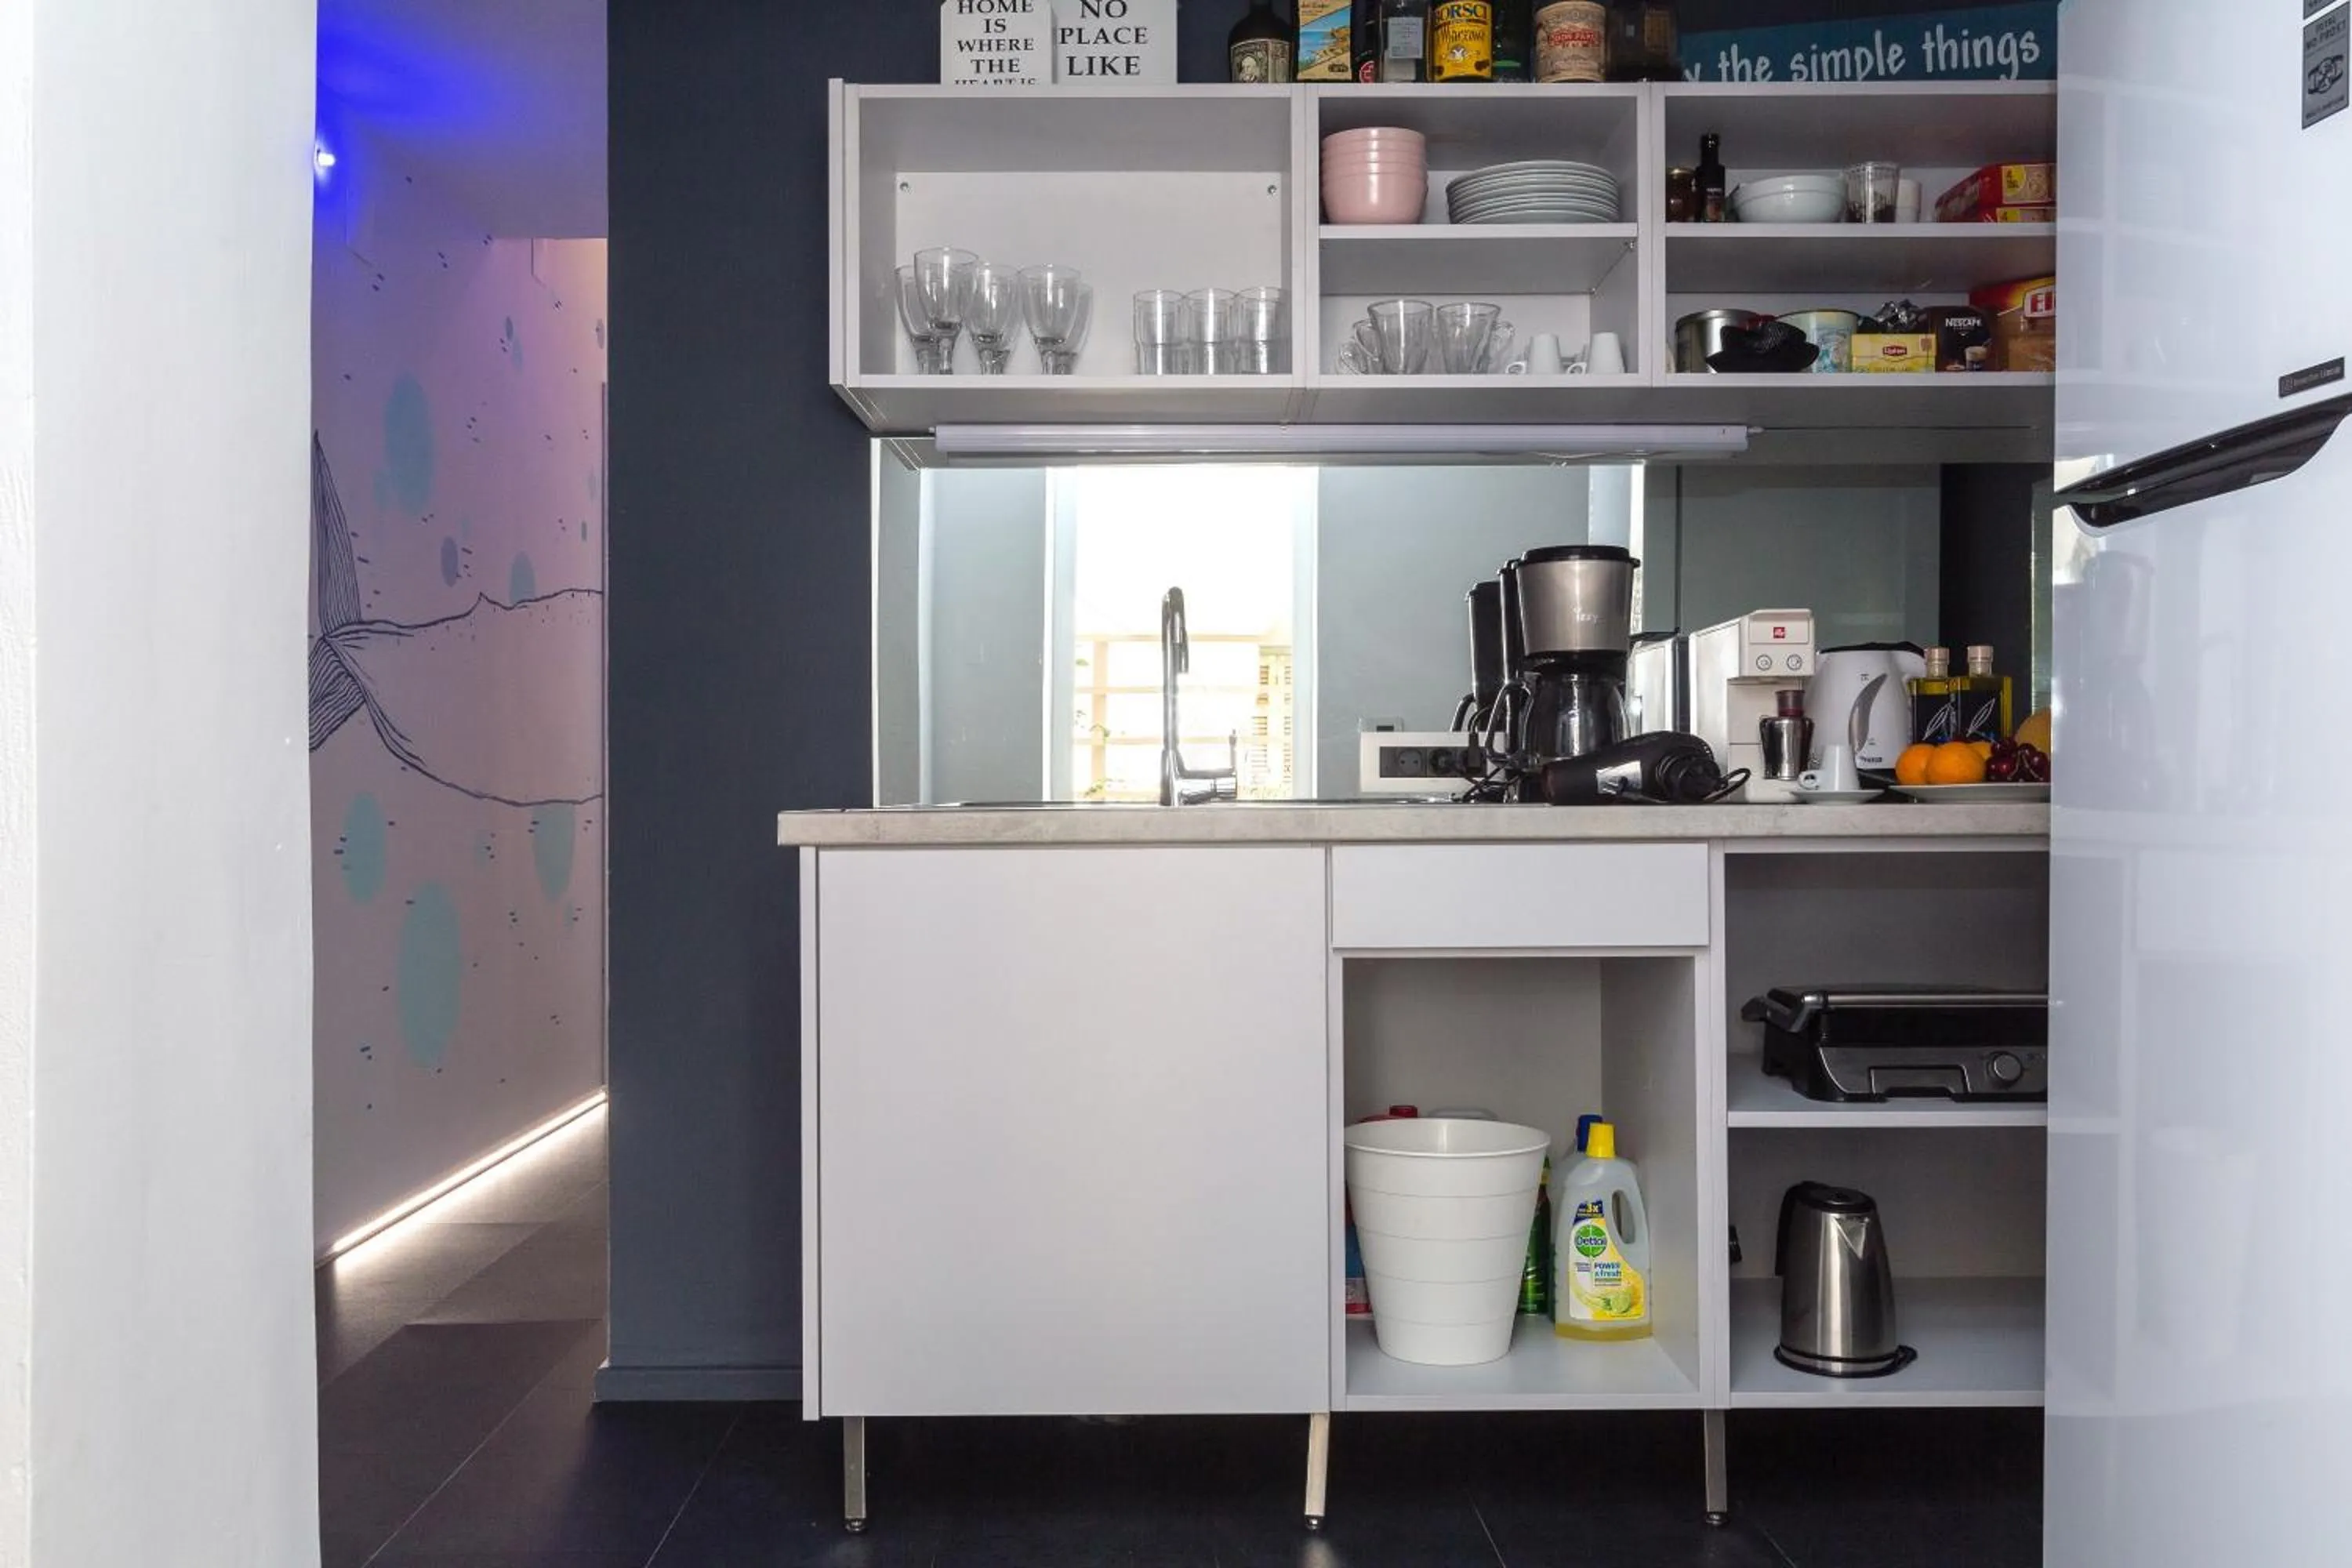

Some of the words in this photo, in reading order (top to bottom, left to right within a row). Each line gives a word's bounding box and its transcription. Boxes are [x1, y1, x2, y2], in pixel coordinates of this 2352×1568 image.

[957, 0, 1034, 13] HOME
[1080, 0, 1127, 19] NO
[983, 18, 1007, 33] IS
[1058, 27, 1149, 45] PLACE
[957, 38, 1035, 53] WHERE
[1719, 43, 1773, 82] the
[1790, 29, 1907, 82] simple
[1922, 24, 2040, 82] things
[971, 58, 1021, 74] THE
[1067, 56, 1141, 76] LIKE
